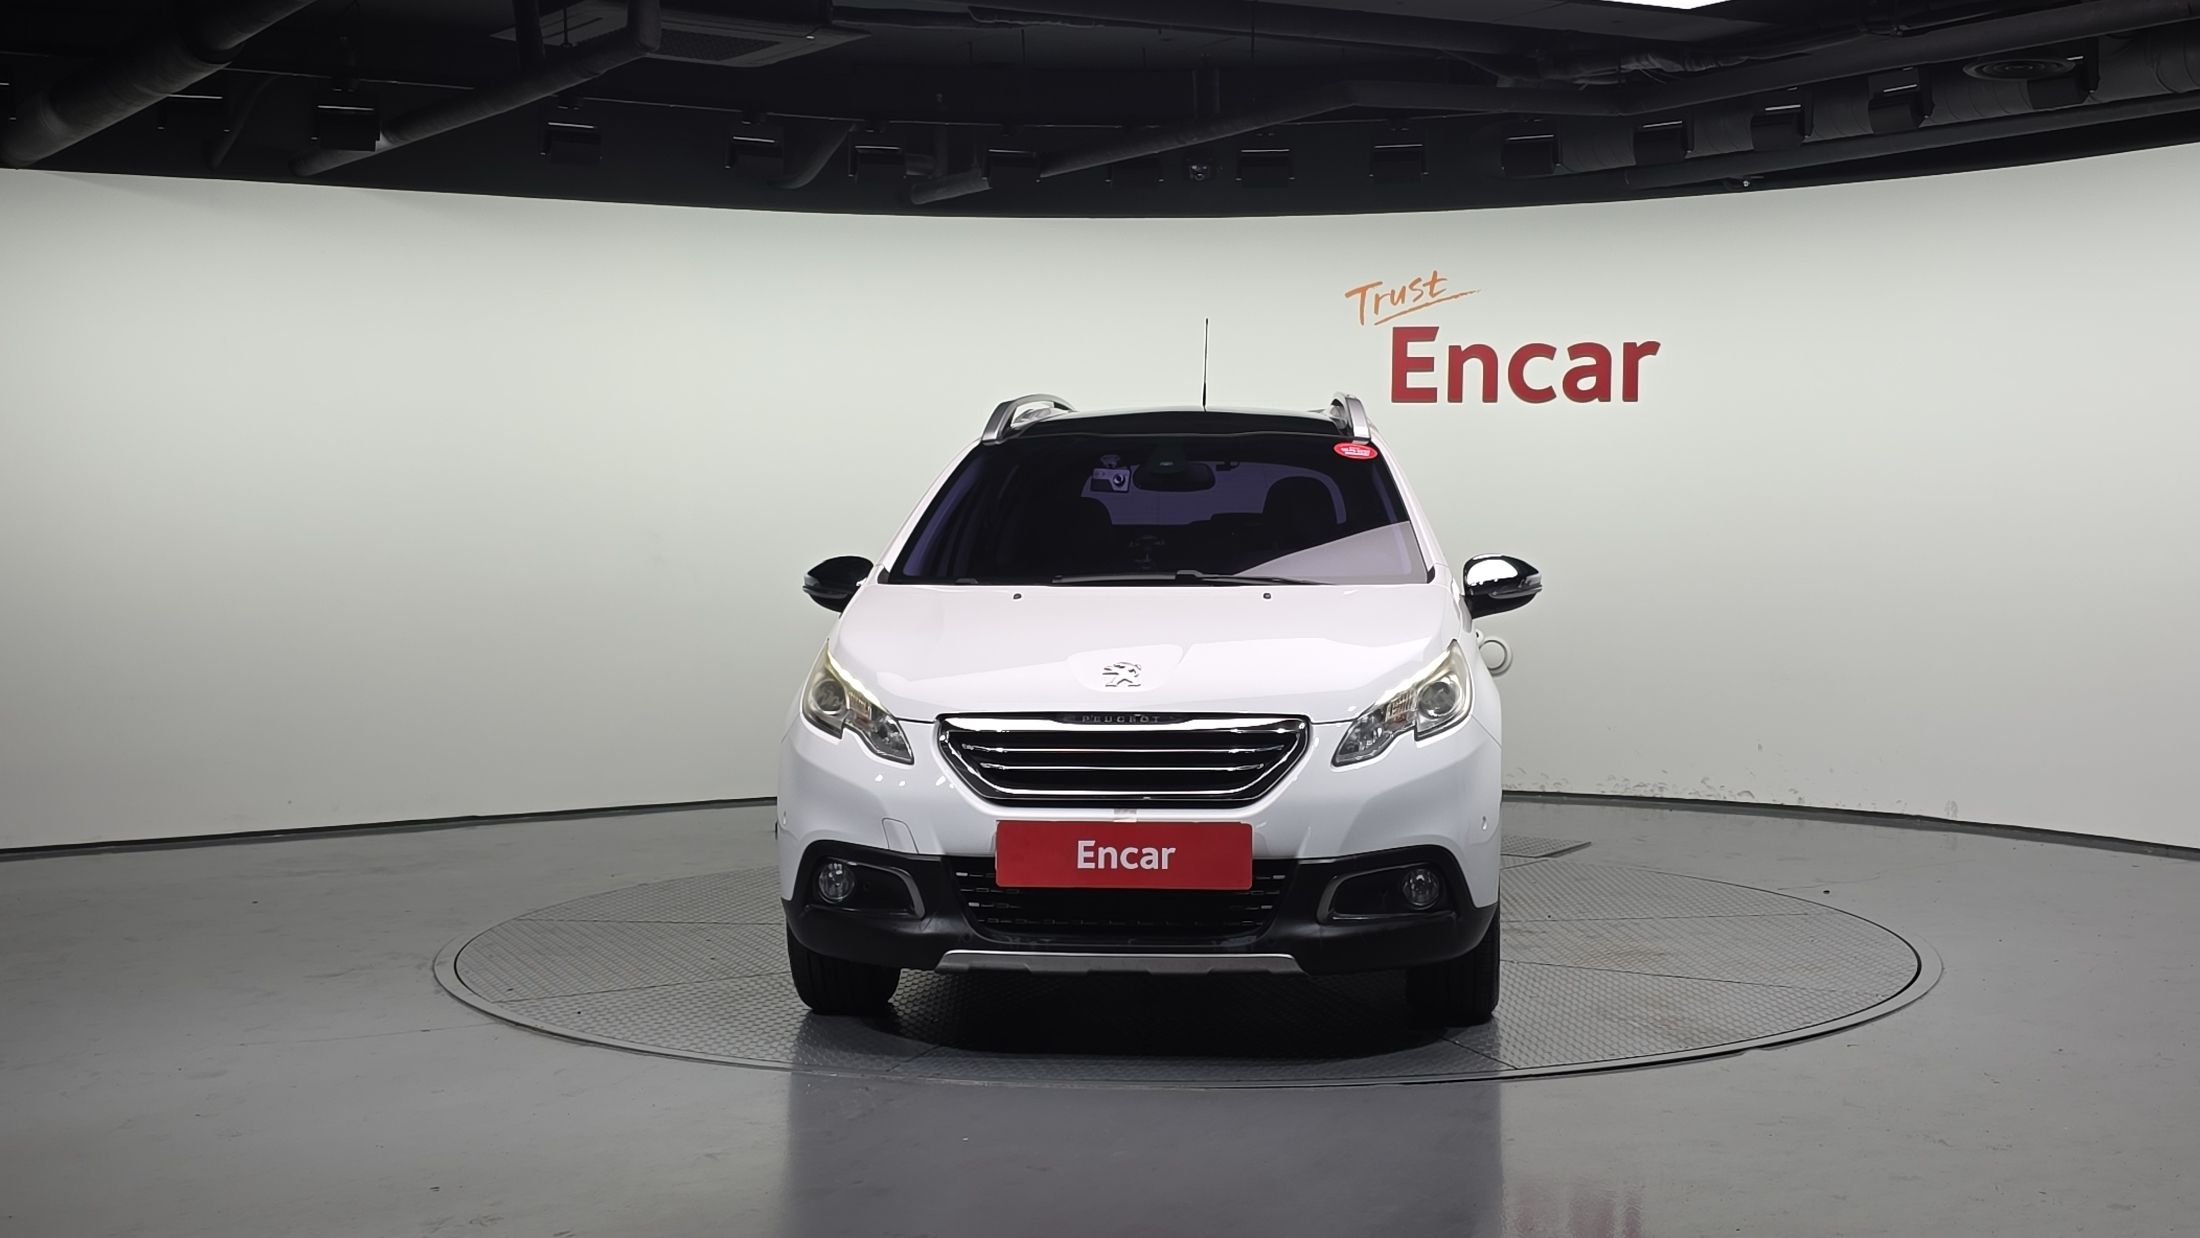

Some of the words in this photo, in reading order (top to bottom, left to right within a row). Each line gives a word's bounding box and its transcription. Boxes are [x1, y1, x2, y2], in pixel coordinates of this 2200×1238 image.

[1345, 270, 1449, 326] Trust
[1391, 326, 1661, 404] Encar
[1077, 840, 1176, 870] Encar
